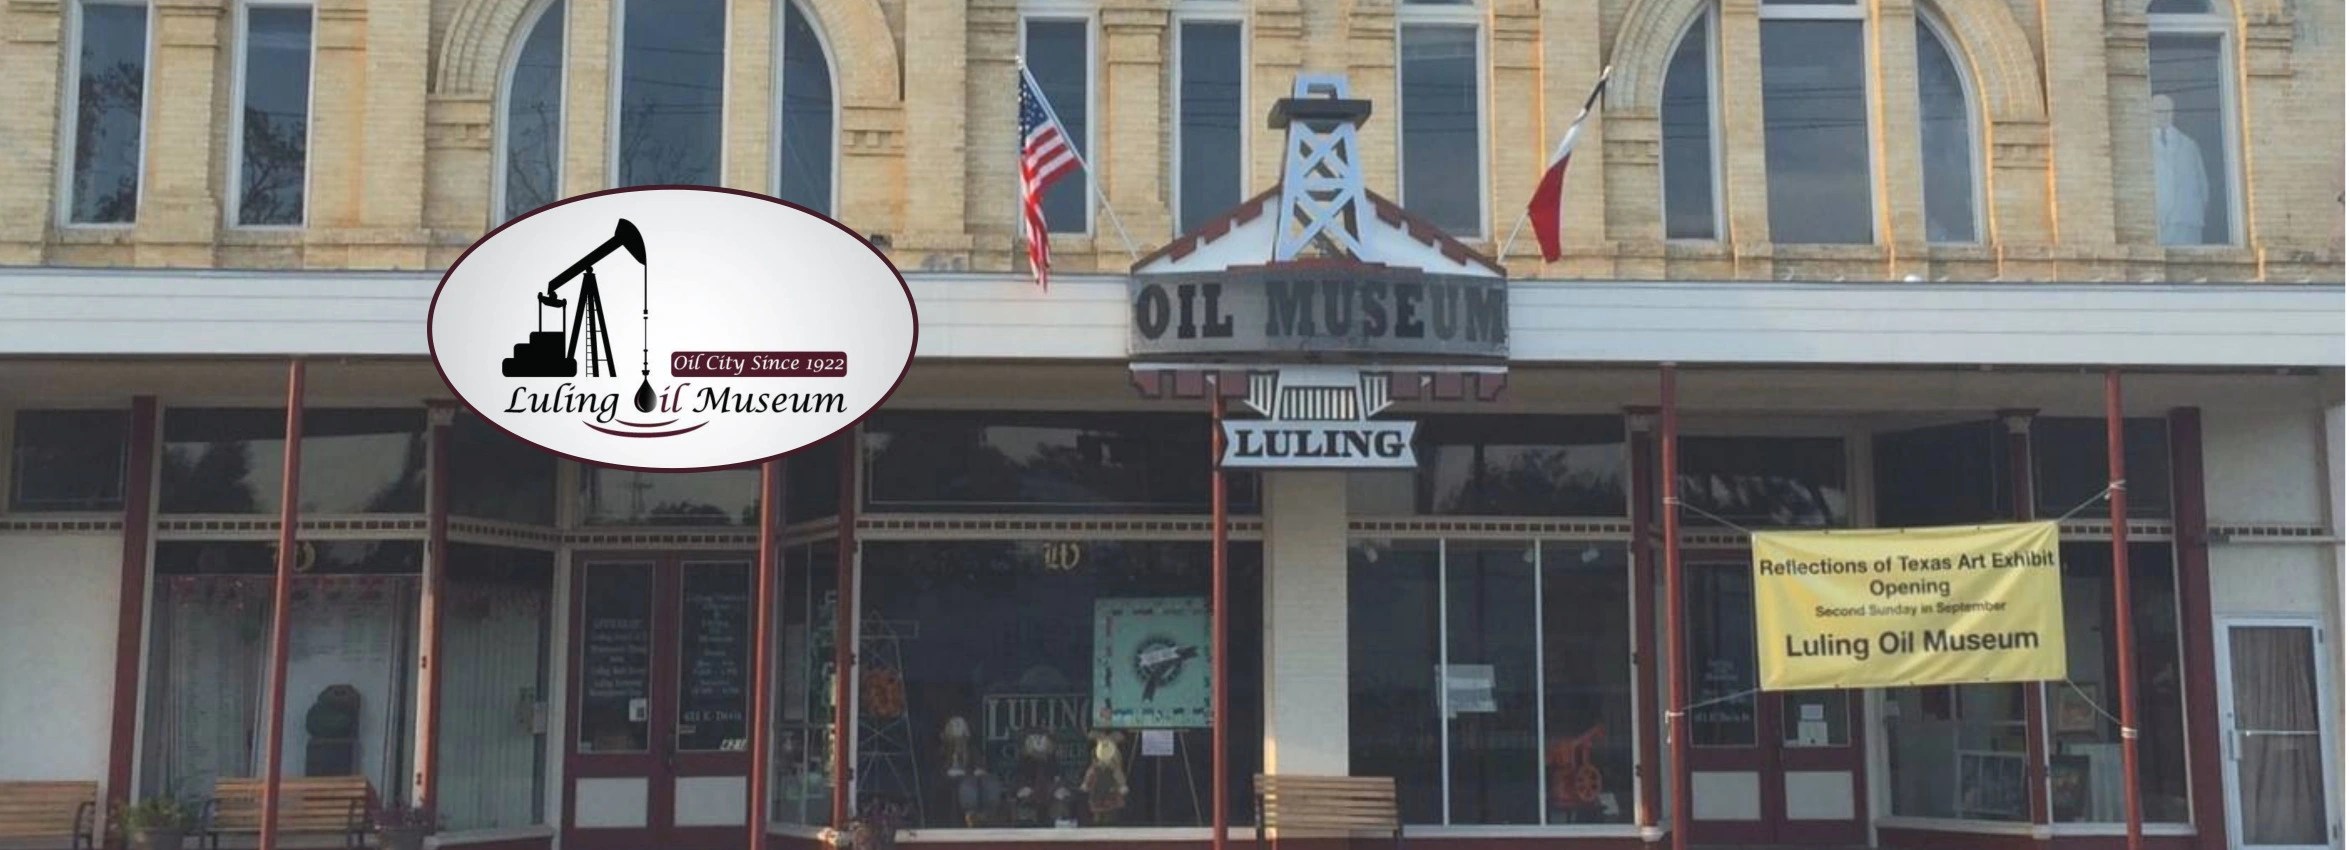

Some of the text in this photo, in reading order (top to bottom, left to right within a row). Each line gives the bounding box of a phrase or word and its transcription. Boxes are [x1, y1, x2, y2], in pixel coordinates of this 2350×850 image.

[1136, 281, 1509, 343] OIL MUSEUM
[1234, 429, 1405, 458] LULING
[1760, 550, 2055, 576] Reflections of Texas Art Exhibit
[1869, 579, 1950, 597] Opening
[1815, 601, 2006, 617] Second Sunday in September
[1785, 629, 2039, 660] Luling Oil Museum
